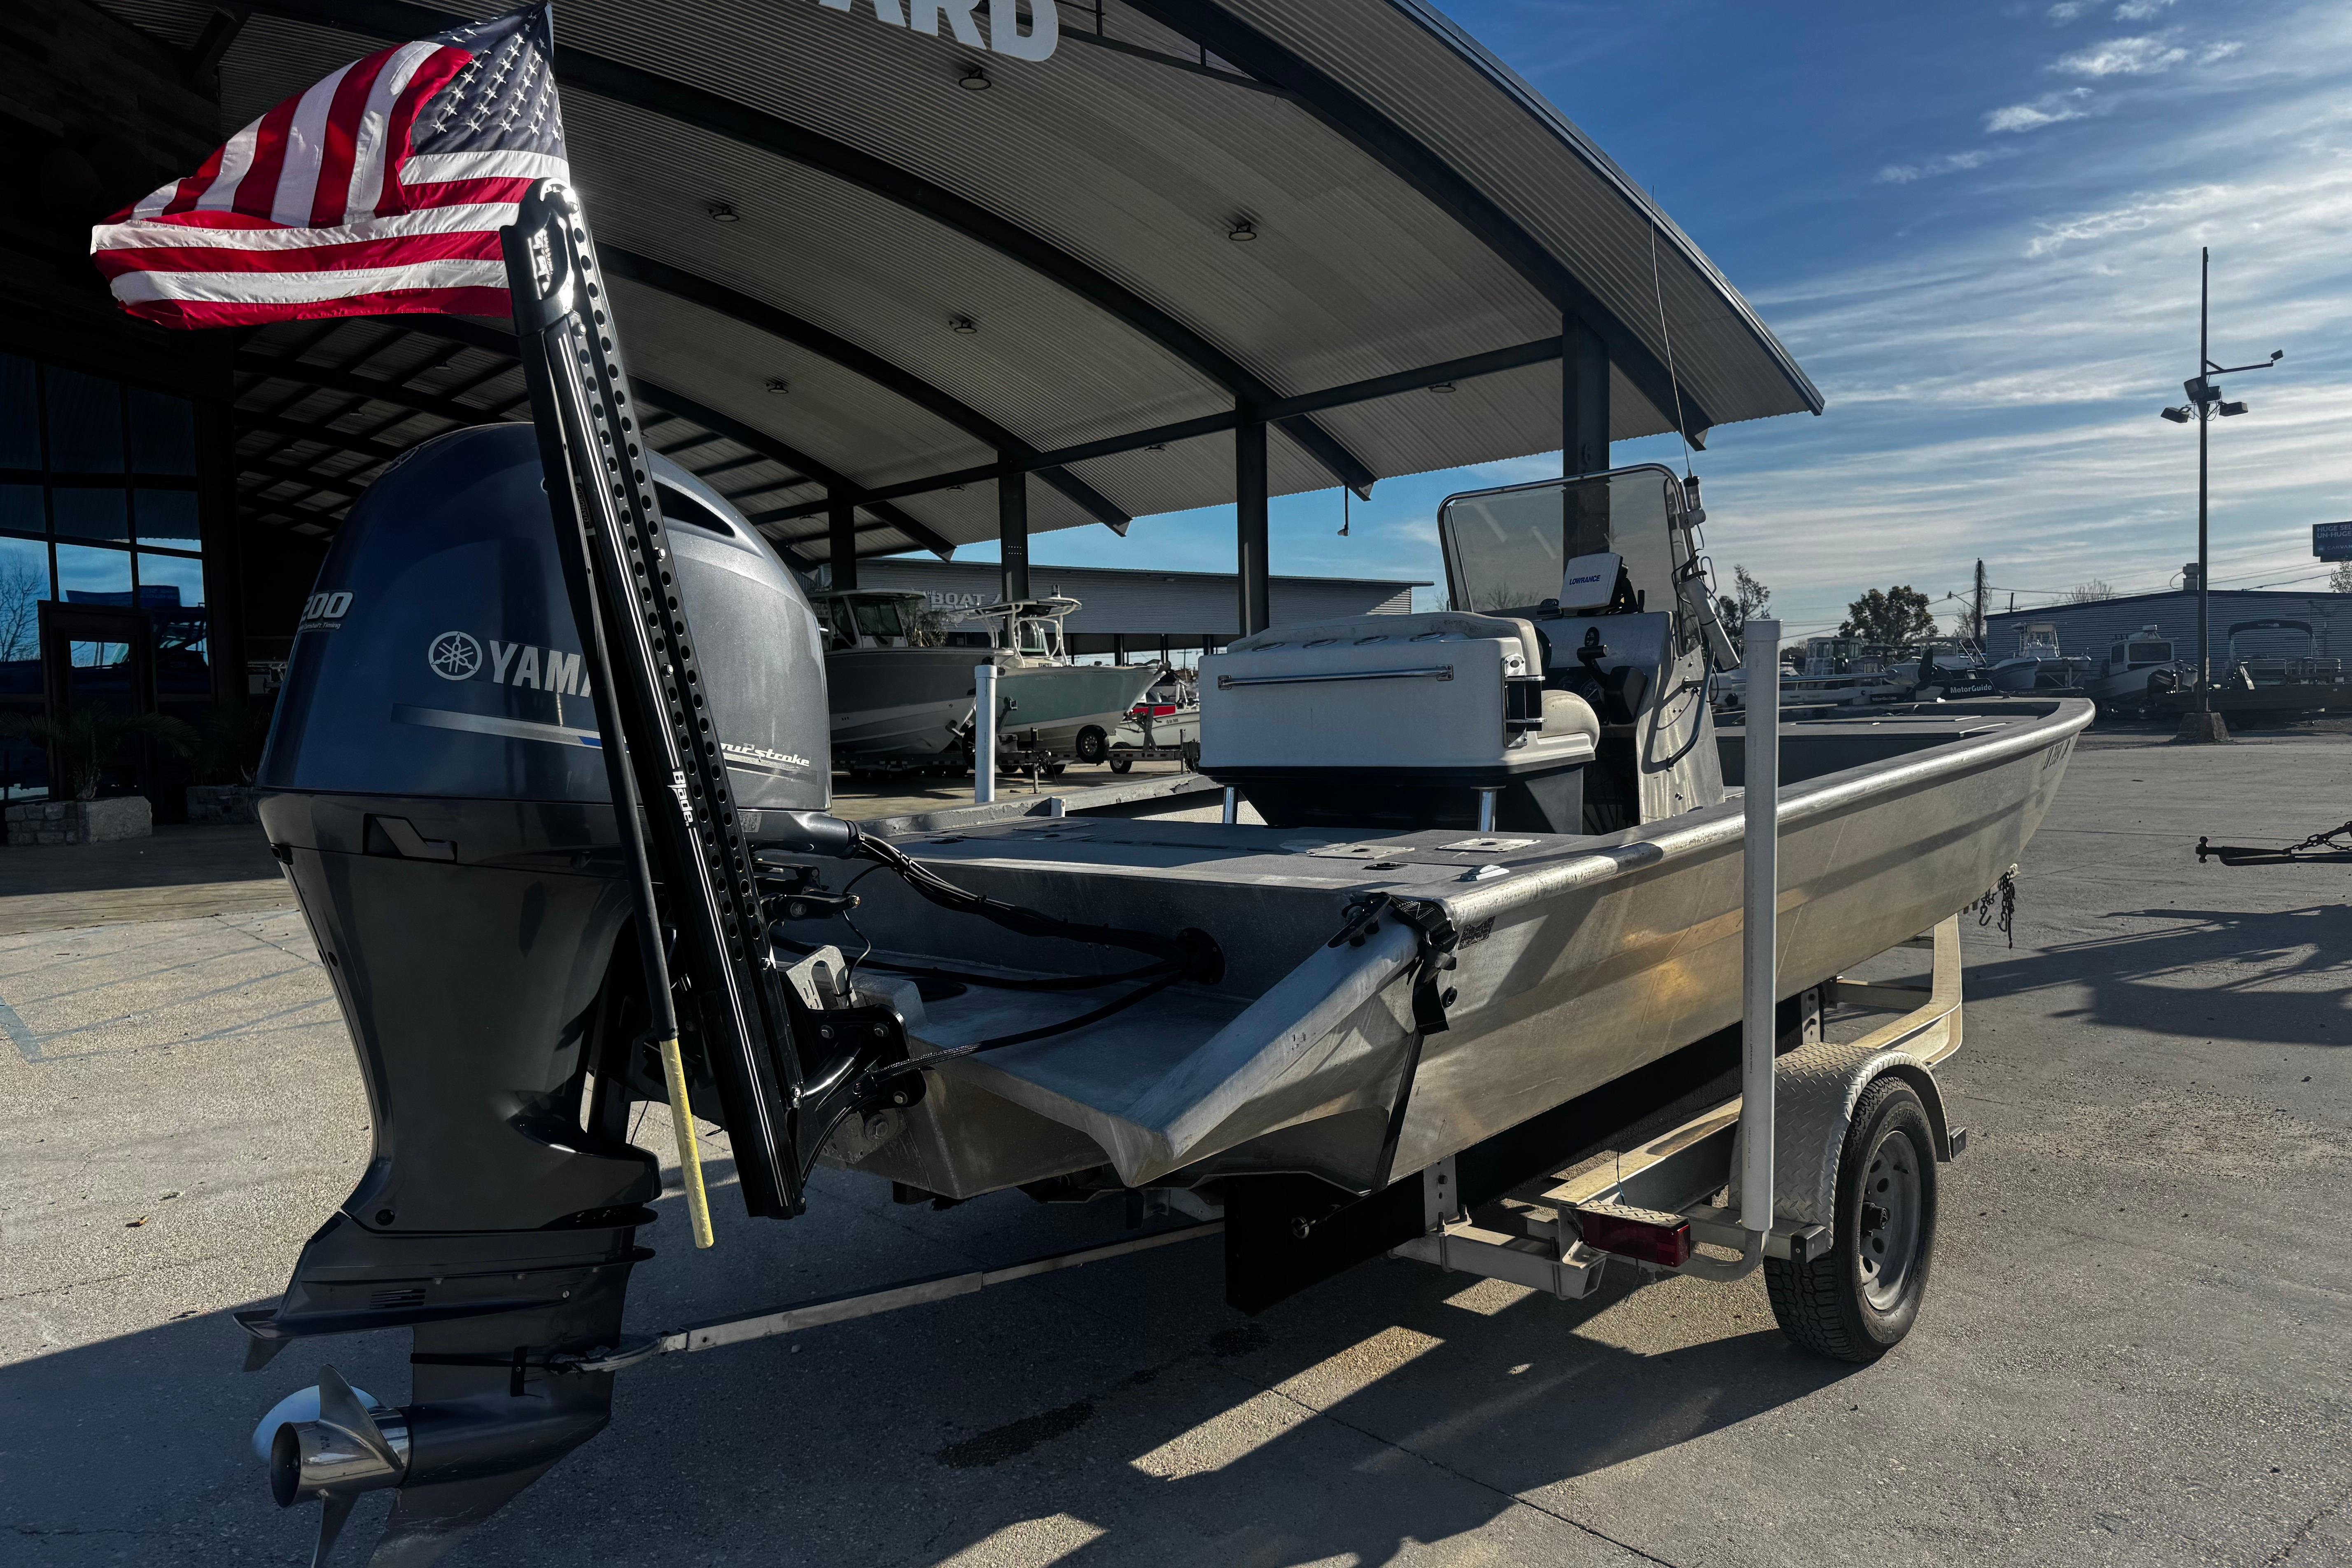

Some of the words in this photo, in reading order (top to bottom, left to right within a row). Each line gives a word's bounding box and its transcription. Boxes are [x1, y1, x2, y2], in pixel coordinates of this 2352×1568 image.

[1569, 575, 1601, 585] LOWRANCE
[931, 593, 986, 605] BOAT
[667, 771, 694, 824] Blade
